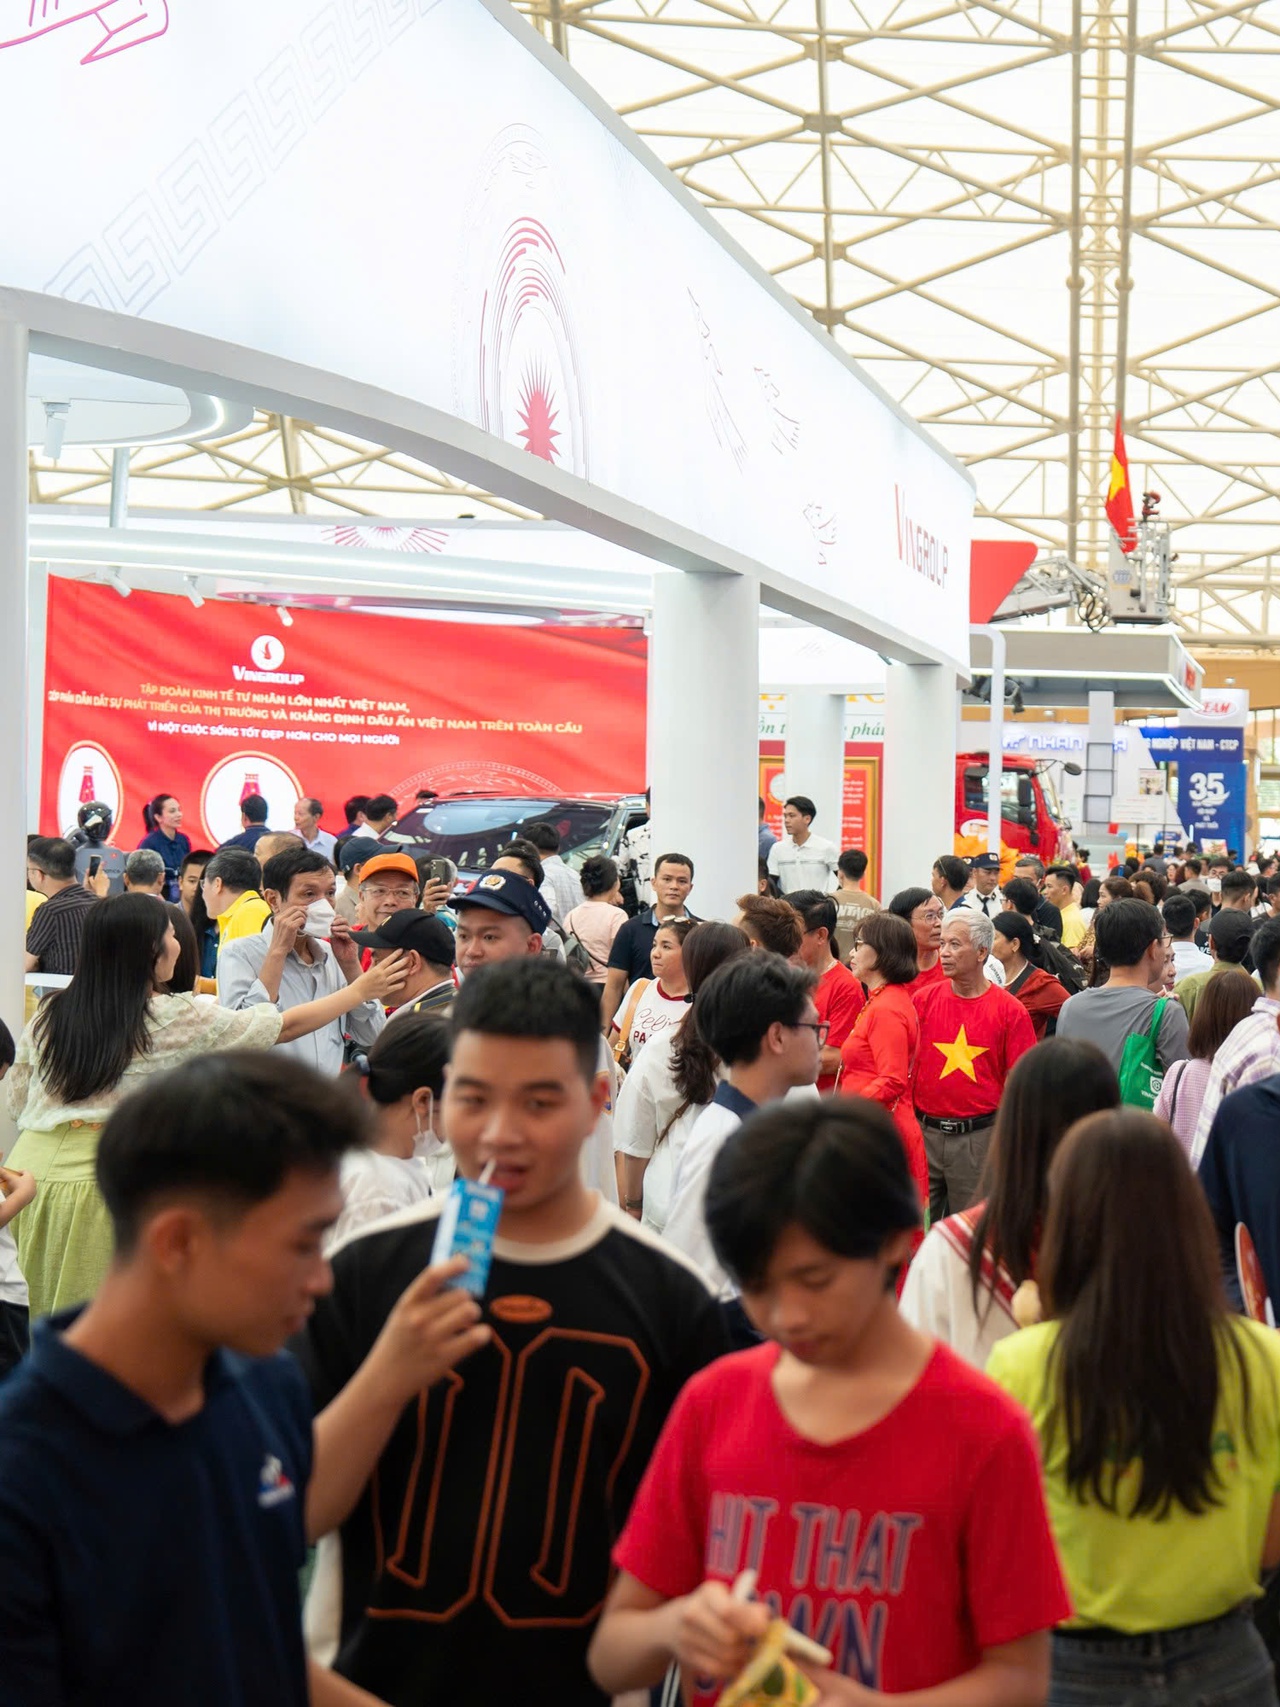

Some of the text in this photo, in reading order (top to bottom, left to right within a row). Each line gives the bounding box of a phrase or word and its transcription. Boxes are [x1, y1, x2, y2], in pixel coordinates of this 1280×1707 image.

[192, 687, 218, 699] KINH
[252, 692, 286, 704] NHÂN
[349, 699, 375, 712] VIỆT
[271, 708, 287, 720] VÀ
[417, 716, 444, 730] VIỆT
[447, 719, 477, 730] NAM
[480, 719, 513, 731] TRÊN
[312, 732, 336, 742] CHO
[1189, 772, 1225, 802] 35
[705, 1490, 924, 1596] HIT THAT
